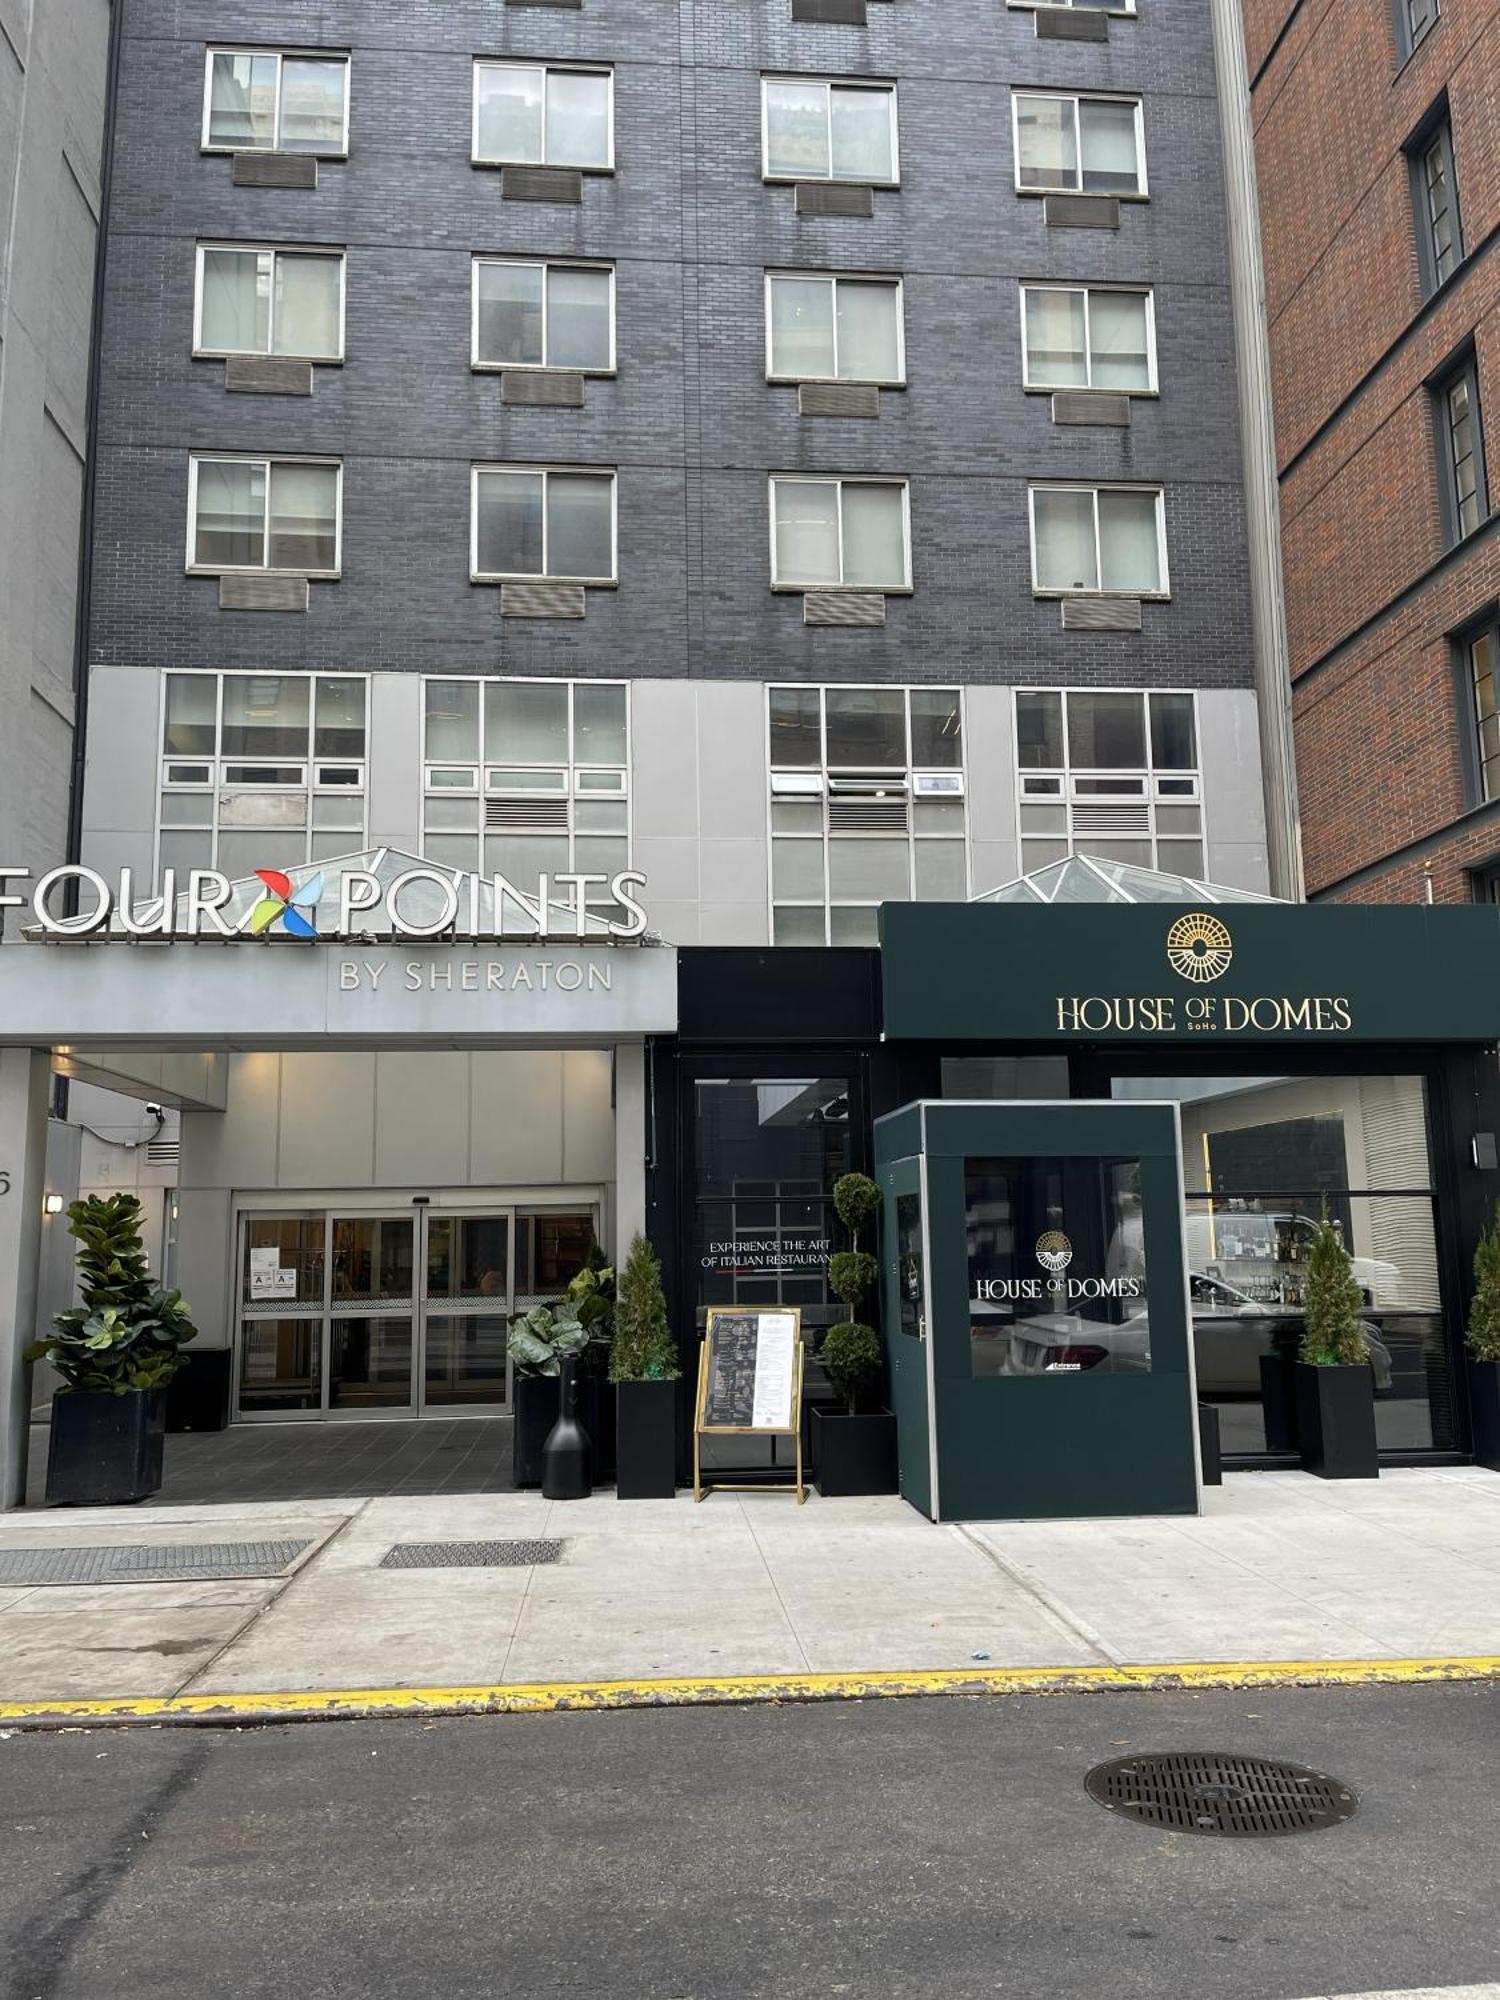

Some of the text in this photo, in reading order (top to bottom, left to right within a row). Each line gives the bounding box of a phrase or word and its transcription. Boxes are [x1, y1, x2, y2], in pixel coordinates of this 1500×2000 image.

[340, 870, 647, 937] POINTS
[339, 961, 612, 991] BY SHERATON
[1056, 997, 1352, 1031] HOUSE OF DOMES
[709, 1239, 831, 1252] EXPERIENCE THE ART
[700, 1253, 832, 1268] OF ITALIAN RESTAURAN
[976, 1278, 1139, 1299] HOUSE OF DOMES
